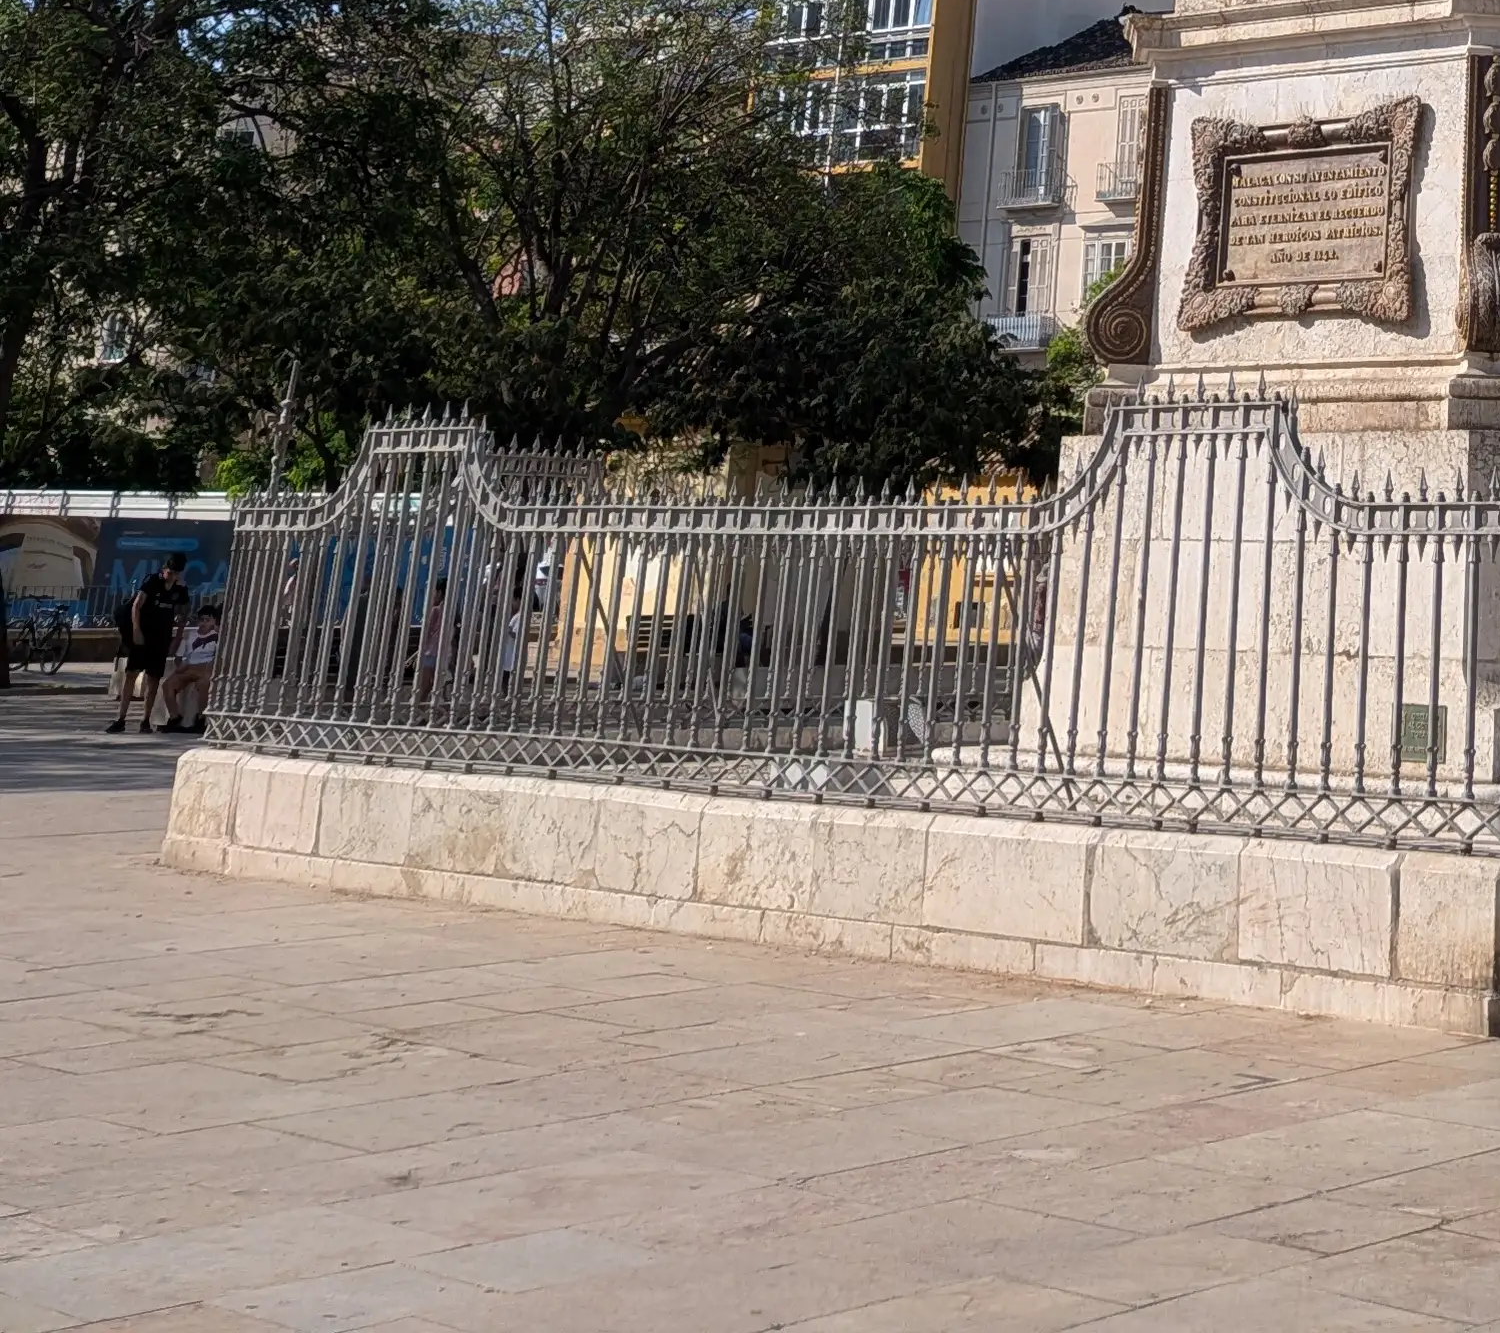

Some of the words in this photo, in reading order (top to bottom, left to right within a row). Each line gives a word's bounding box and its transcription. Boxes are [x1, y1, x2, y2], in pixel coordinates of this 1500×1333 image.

[1294, 172, 1307, 184] SU
[1323, 190, 1339, 201] LO
[1318, 209, 1332, 221] EL
[1332, 206, 1385, 220] RECUERDO
[1229, 235, 1243, 247] DE
[1245, 234, 1266, 246] TAN
[1270, 247, 1293, 264] AÑO
[1296, 251, 1311, 262] DE
